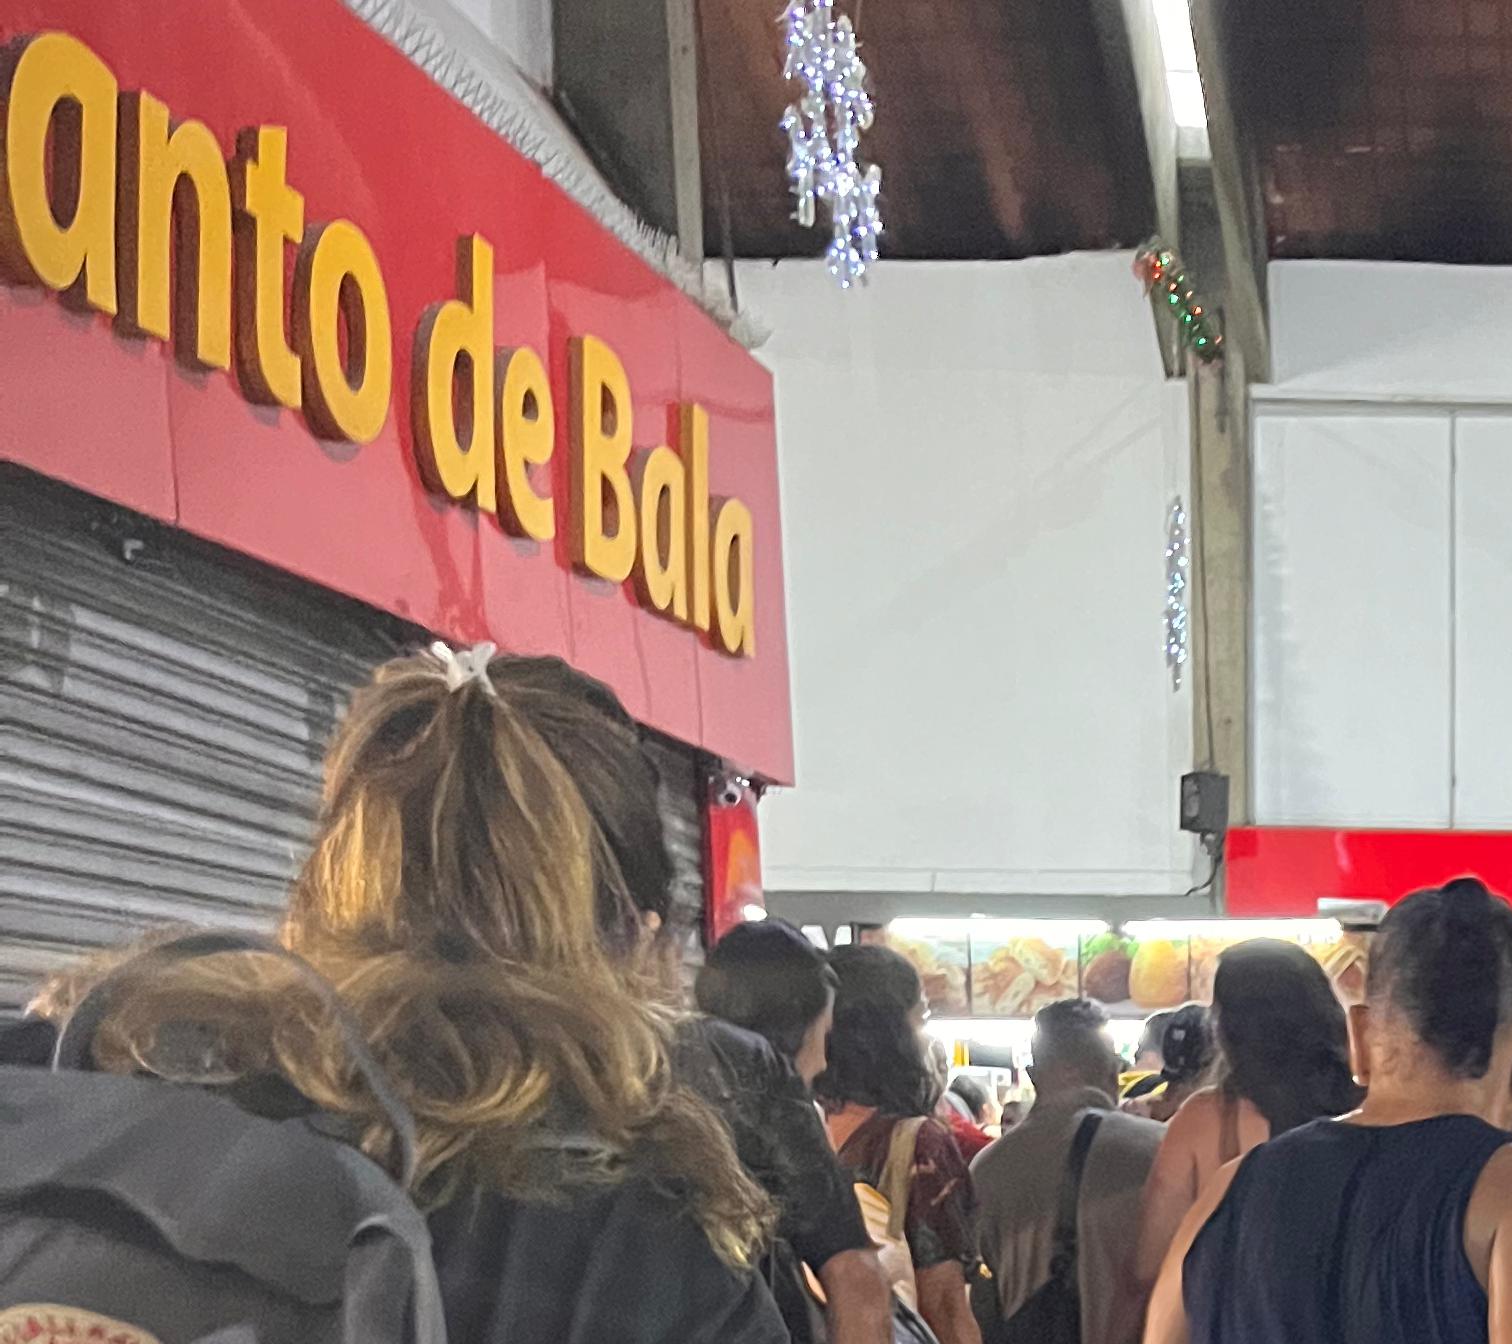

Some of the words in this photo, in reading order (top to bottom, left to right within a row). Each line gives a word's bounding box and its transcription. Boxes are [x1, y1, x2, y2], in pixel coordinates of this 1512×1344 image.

[6, 30, 393, 444] anto
[420, 231, 556, 543] de
[574, 333, 756, 659] Bala
